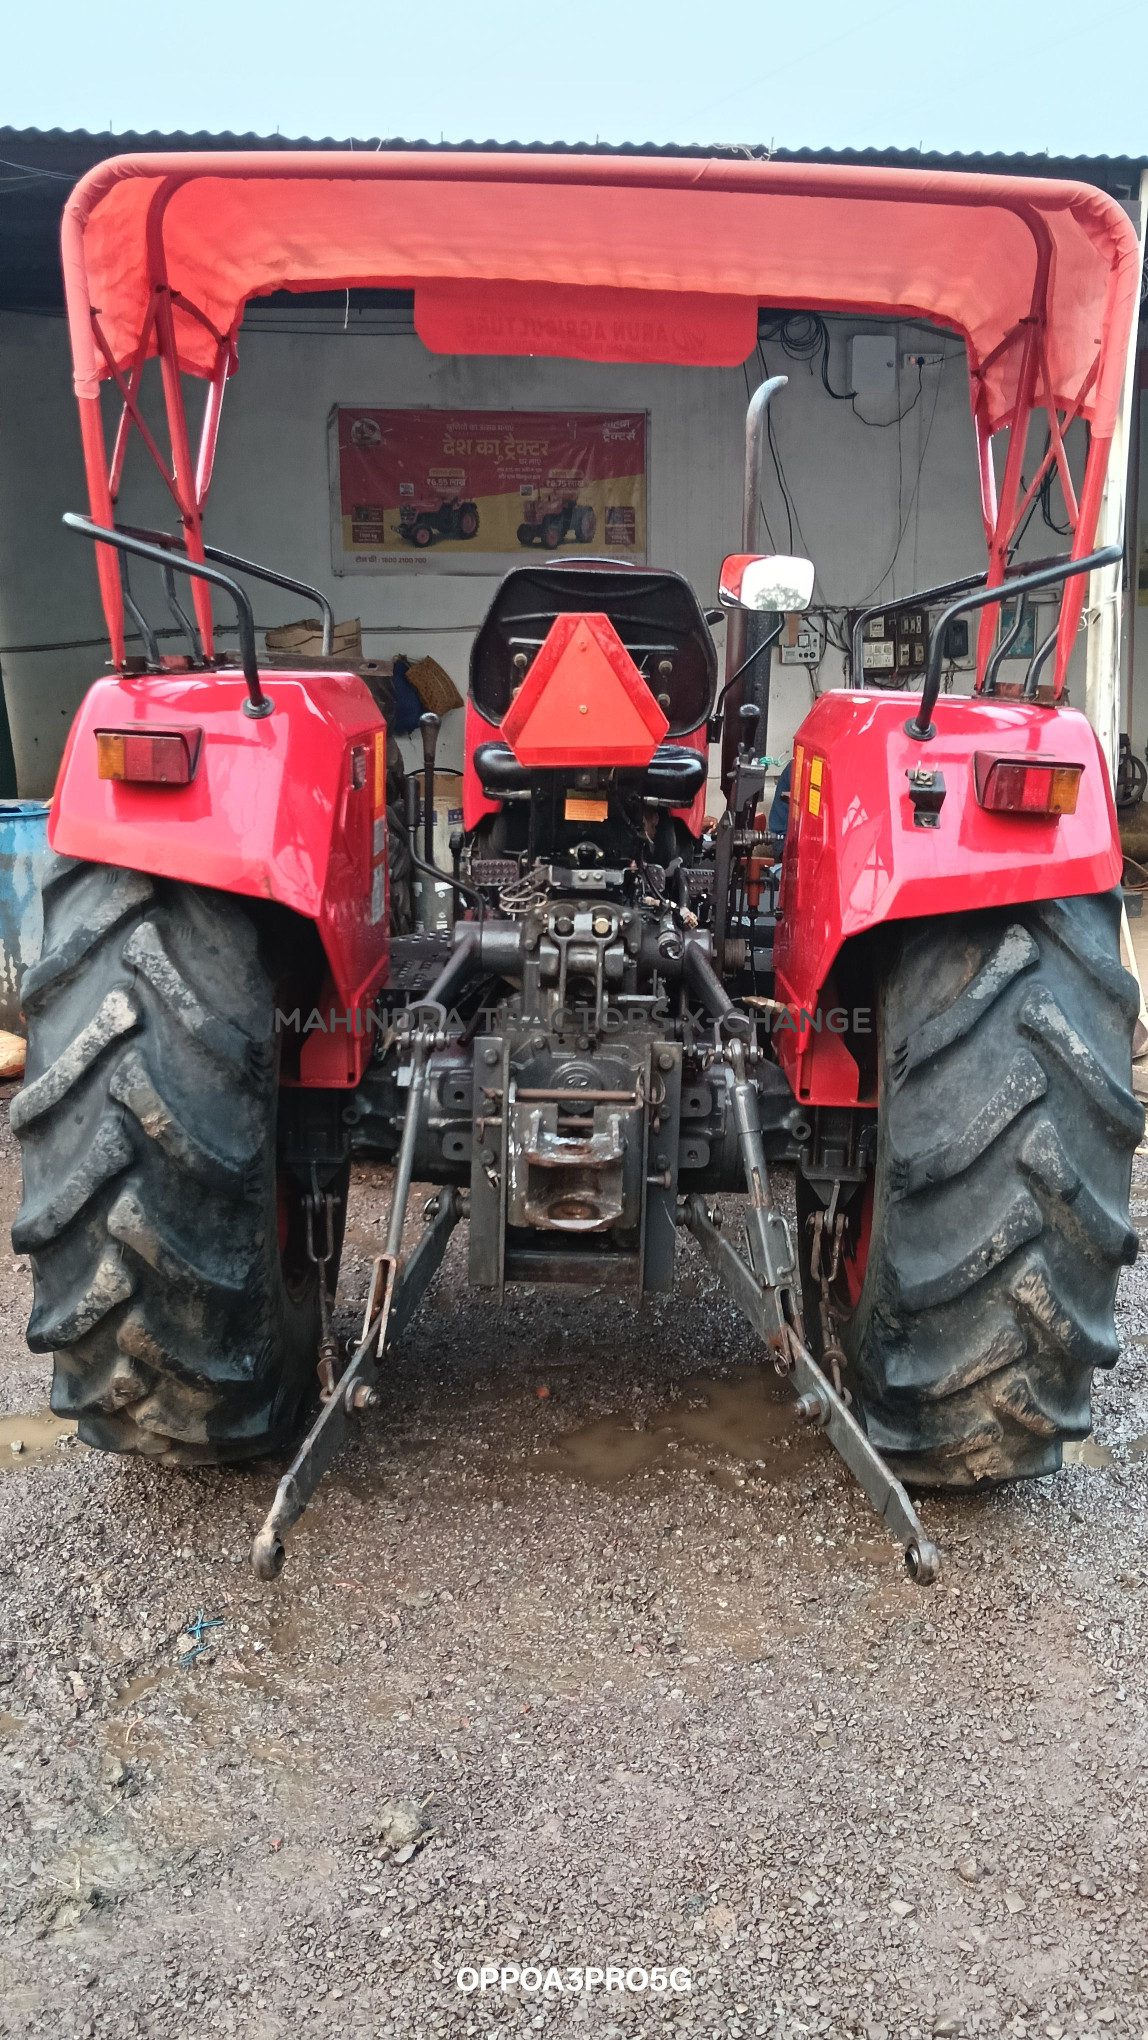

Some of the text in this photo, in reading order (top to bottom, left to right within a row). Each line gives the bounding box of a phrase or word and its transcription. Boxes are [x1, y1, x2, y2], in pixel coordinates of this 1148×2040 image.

[442, 432, 549, 460] देश का ट्रैक्टर
